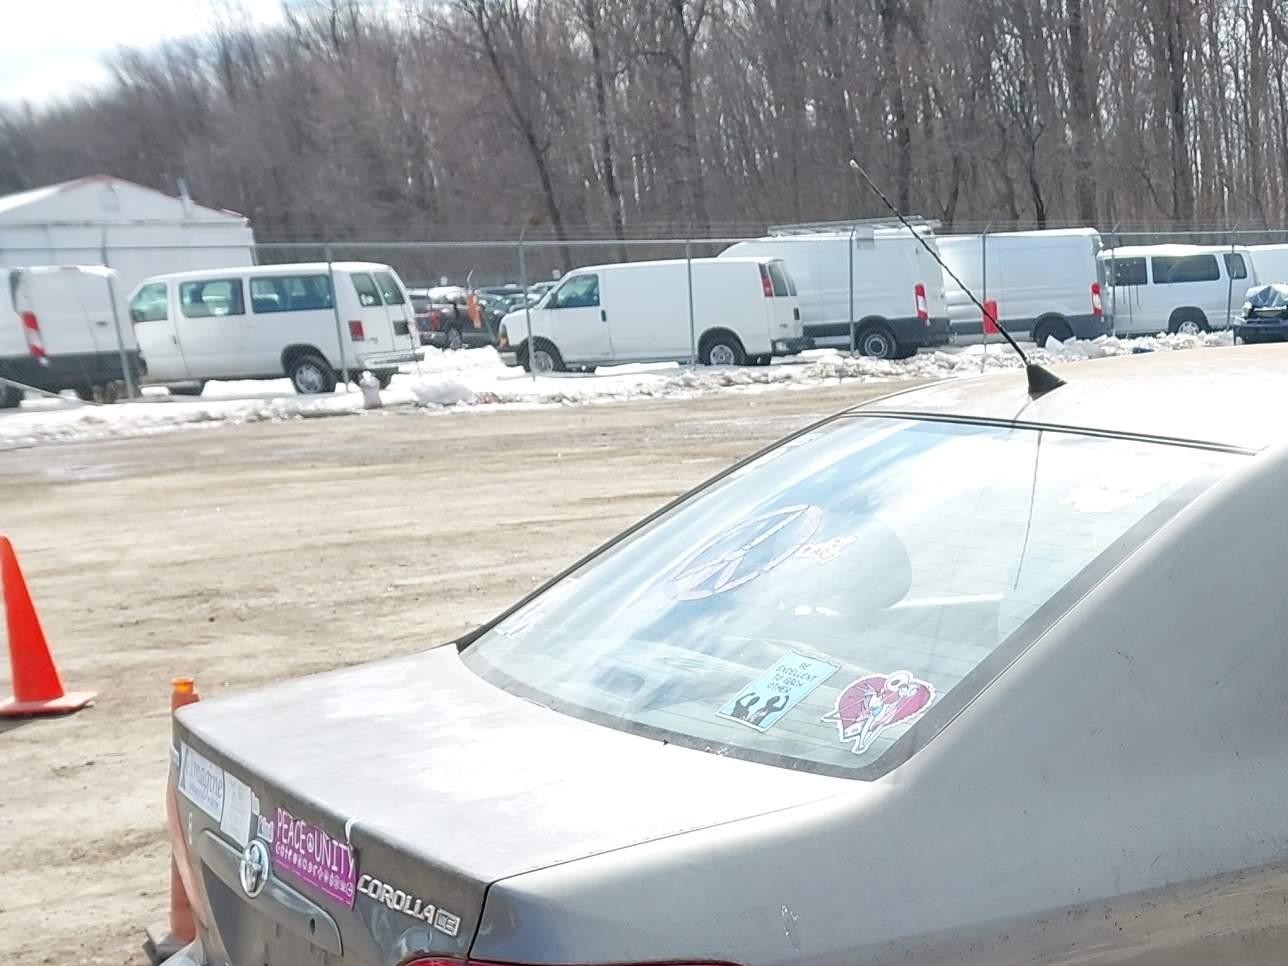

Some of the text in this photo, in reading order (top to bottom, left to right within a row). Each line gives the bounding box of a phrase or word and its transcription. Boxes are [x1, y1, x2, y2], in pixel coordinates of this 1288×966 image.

[277, 807, 306, 856] PEACE
[315, 830, 354, 880] UNITY
[357, 874, 436, 925] COROLLA
